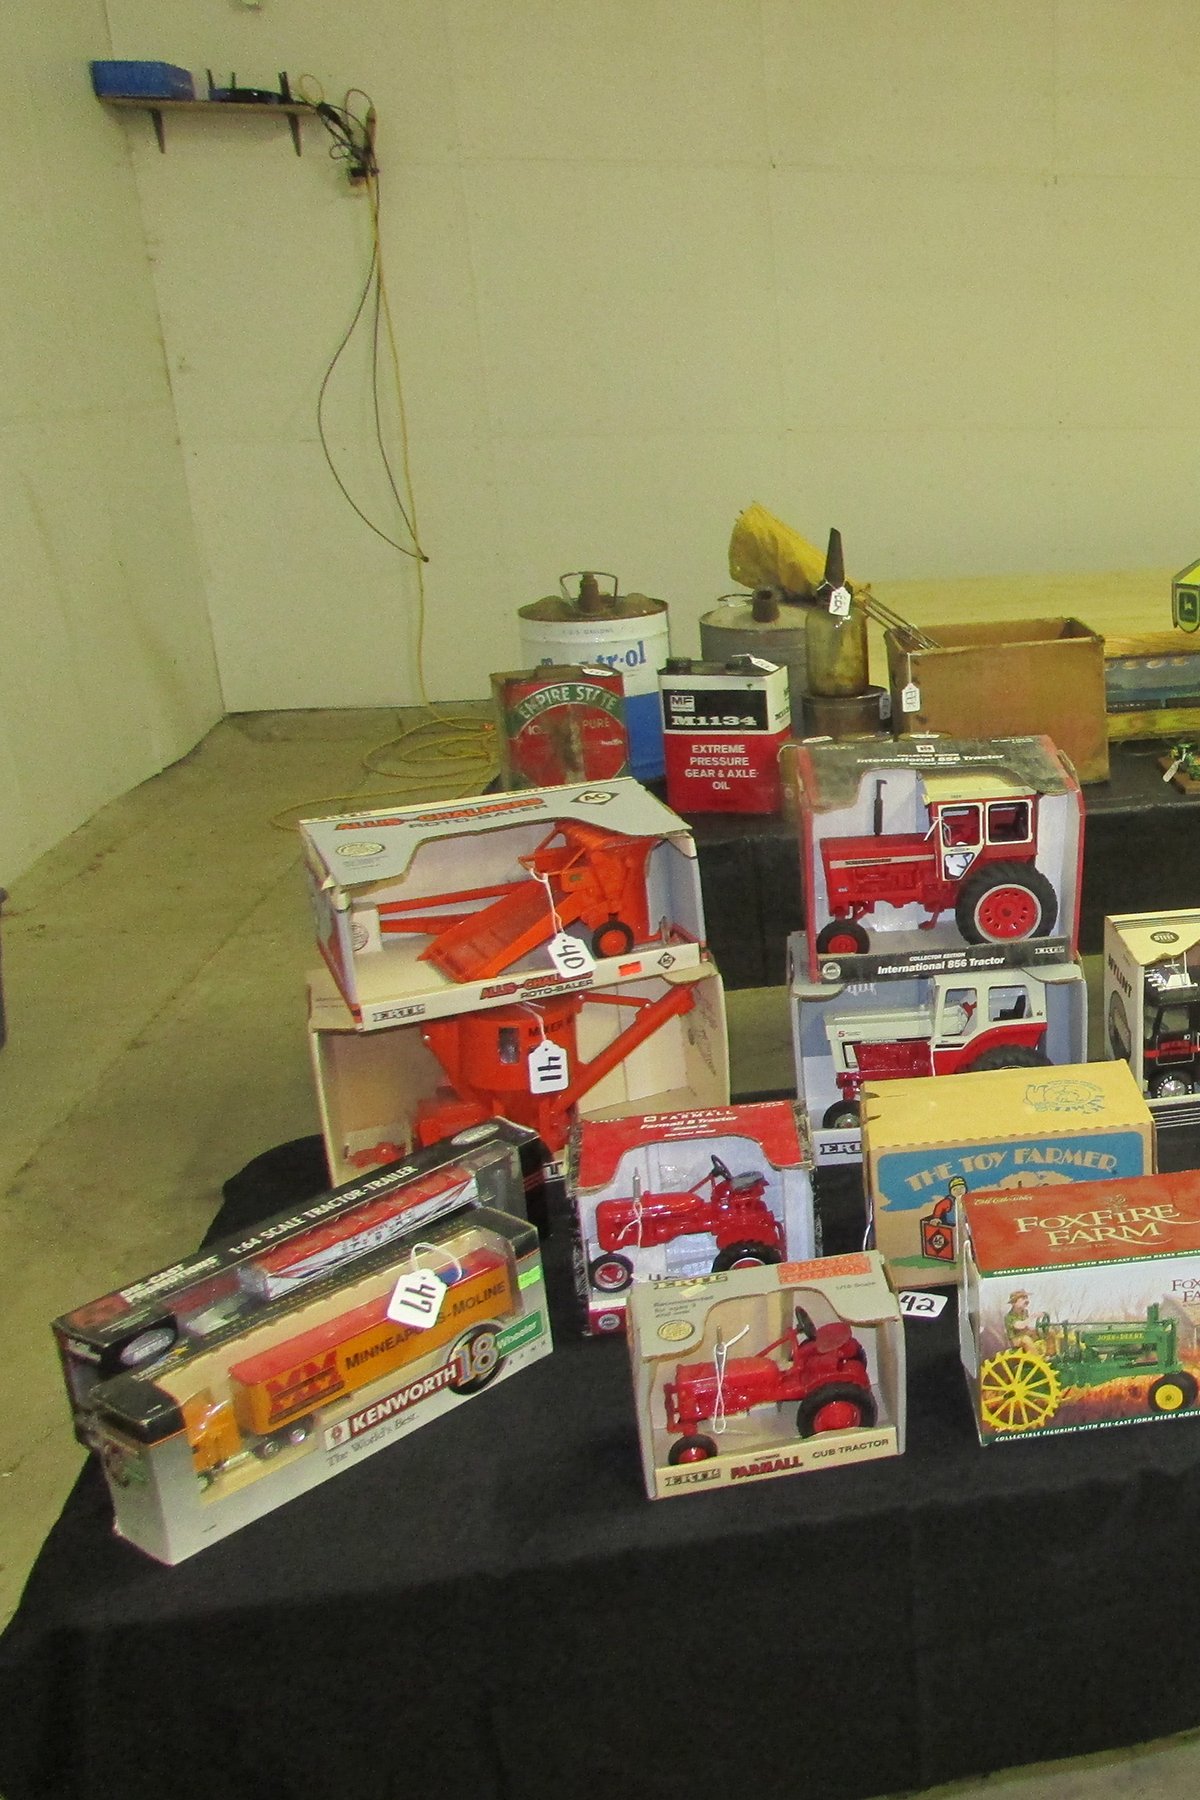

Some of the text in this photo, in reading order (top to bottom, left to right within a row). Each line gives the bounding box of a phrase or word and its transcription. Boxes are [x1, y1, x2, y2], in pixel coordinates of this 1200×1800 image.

[518, 686, 570, 718] EMPIRE
[672, 714, 758, 726] M1134
[691, 744, 746, 755] EXTREME
[856, 756, 936, 764] International
[963, 754, 1005, 762] Tractor
[689, 756, 750, 767] PRESSURE
[684, 768, 758, 779] GEAR & AXLE
[582, 792, 608, 802] AC
[712, 780, 731, 791] OIL
[334, 797, 544, 831] ALLIS-CHALMERS
[408, 804, 549, 830] ROTO-BALER
[560, 944, 586, 970] 40
[908, 950, 967, 962] COLLECTOR EDITION
[1034, 946, 1066, 955] ERTL
[877, 956, 1006, 976] International 856 Tractor
[1108, 952, 1134, 999] NYLINT
[520, 978, 594, 999] ROTO-BALER
[372, 1004, 426, 1022] ERTL
[536, 1056, 564, 1082] 41
[640, 1119, 684, 1130] Farmall
[697, 1115, 739, 1126] Tractor
[660, 1109, 734, 1122] FARMALL
[904, 1148, 1118, 1193] THE TOY FARMER
[228, 1164, 419, 1256] 1:64 SCALE TRACTOR-TRAILER
[1046, 1222, 1168, 1248] FARM
[992, 1266, 1040, 1276] COLLECTIBLE
[1040, 1262, 1076, 1272] FIGURINE
[1076, 1260, 1097, 1268] WITH
[1098, 1257, 1132, 1266] DIE-CAST
[1132, 1254, 1153, 1262] JOHN
[1154, 1252, 1175, 1260] DEERE
[400, 1281, 438, 1314] 47
[900, 1293, 937, 1313] 42
[498, 1320, 538, 1350] Wheeler
[458, 1332, 500, 1387] 18
[352, 1366, 458, 1433] KENWORTH
[994, 1430, 1042, 1442] COLLECTIBLE
[1042, 1426, 1078, 1438] FIGURINE
[1078, 1423, 1099, 1432] WITH
[1100, 1418, 1132, 1428] DIE-CAST
[1132, 1415, 1154, 1425] JOHN
[1154, 1412, 1177, 1422] DEERE
[326, 1428, 389, 1468] The World's
[812, 1438, 890, 1460] CUB TRACTOR
[664, 1468, 722, 1488] ERTL
[730, 1454, 804, 1481] FARMALL
